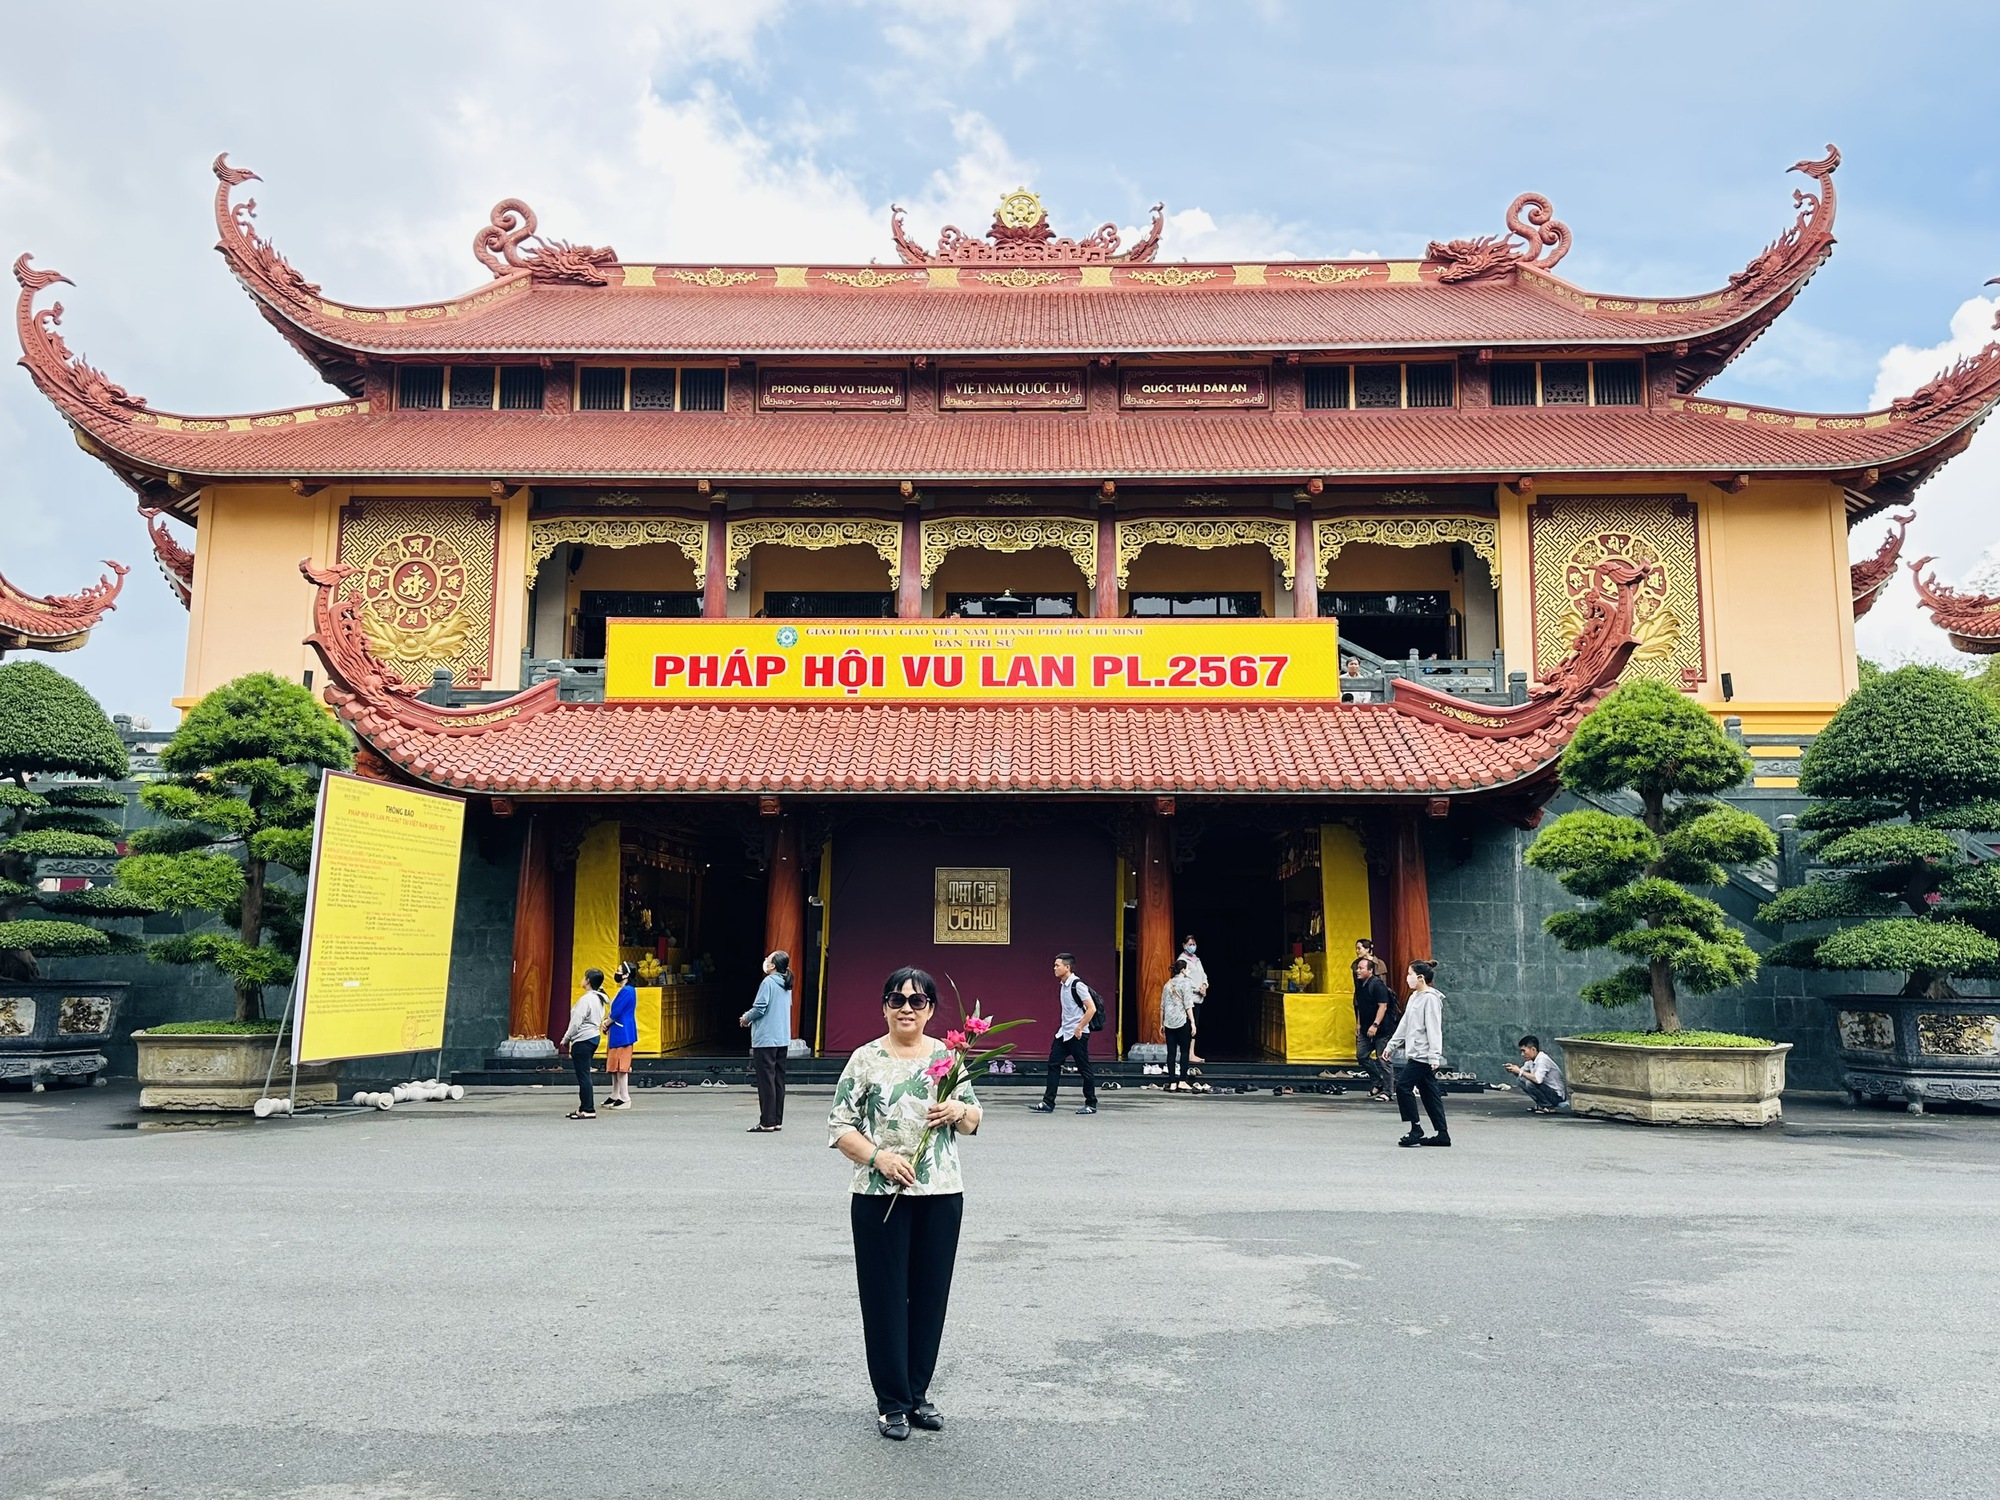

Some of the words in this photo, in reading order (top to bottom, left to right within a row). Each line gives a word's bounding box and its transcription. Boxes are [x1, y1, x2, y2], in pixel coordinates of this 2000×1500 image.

[771, 385, 811, 394] PHONG
[955, 381, 984, 396] VIỆT
[986, 382, 1014, 394] NAM
[1141, 381, 1174, 394] QUỐC
[1230, 383, 1247, 393] AN
[839, 627, 861, 637] HỘI
[932, 627, 960, 637] VIỆT
[963, 628, 989, 636] NAM
[1112, 628, 1144, 636] MINH
[934, 639, 963, 648] BAN
[654, 648, 787, 687] PHÁP
[803, 648, 884, 695] HỘI
[902, 655, 964, 687] VU
[981, 655, 1074, 687] LAN
[1092, 655, 1289, 687] PL.2567
[385, 805, 403, 816] THÔNG
